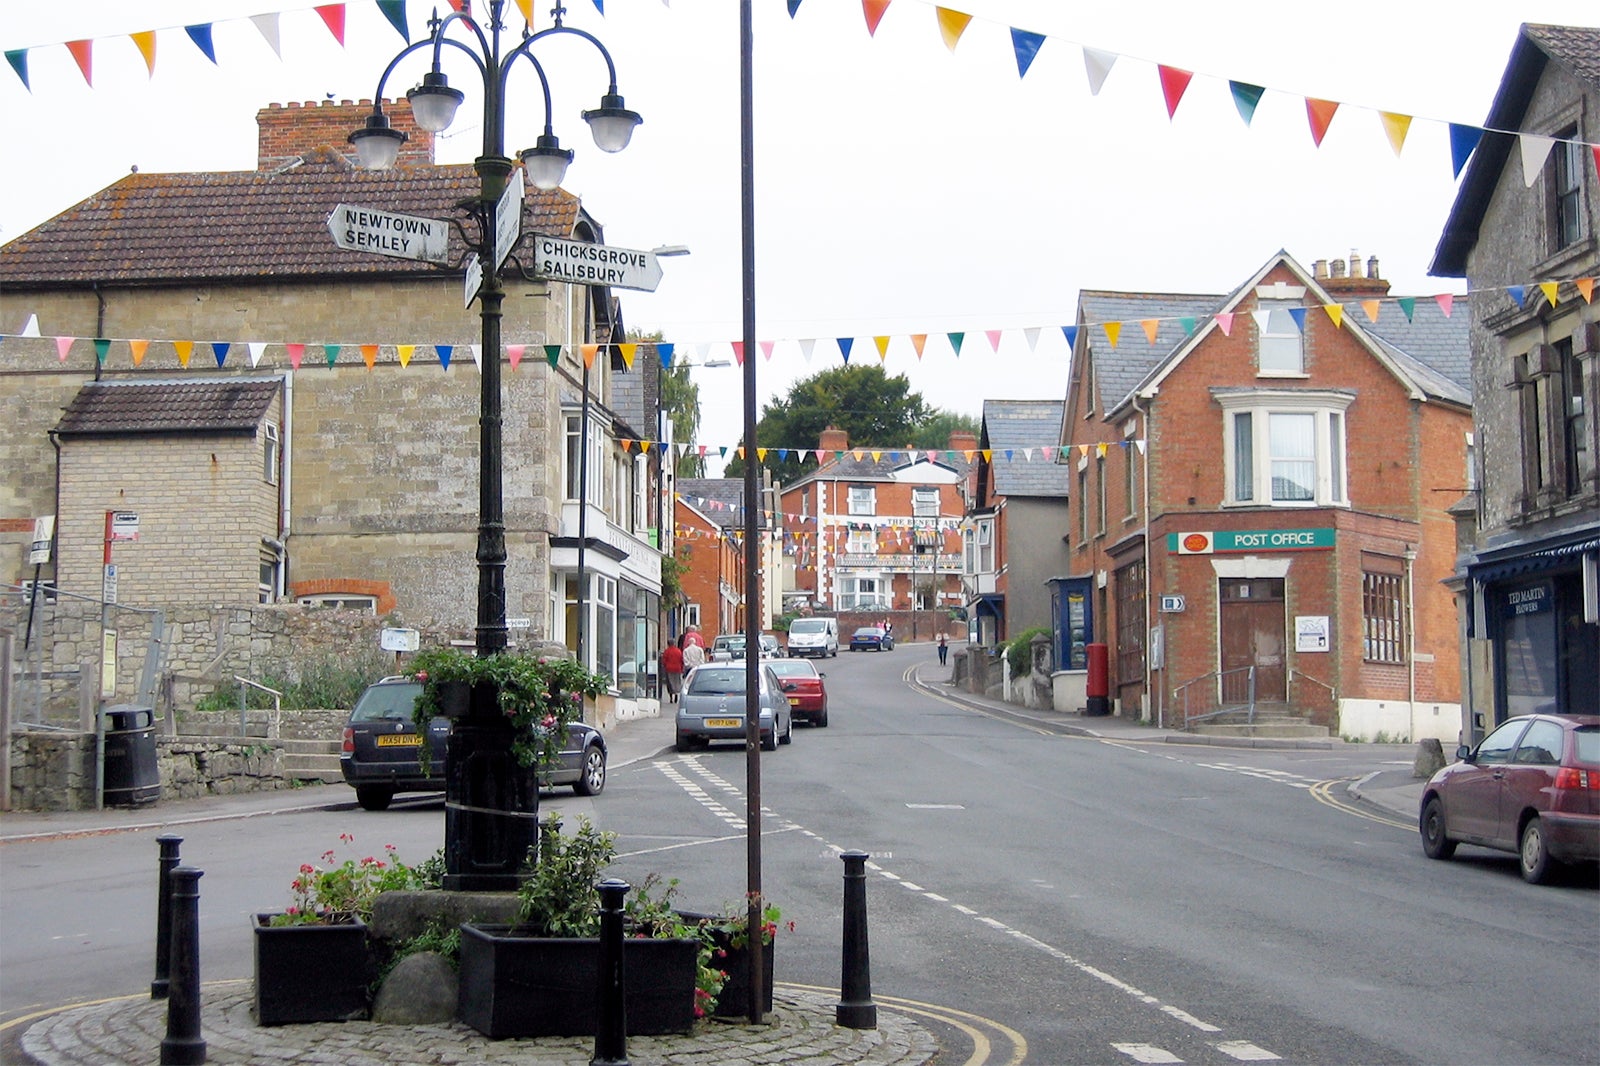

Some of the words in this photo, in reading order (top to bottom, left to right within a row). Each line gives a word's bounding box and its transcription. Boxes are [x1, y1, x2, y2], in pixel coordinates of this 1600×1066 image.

[345, 211, 431, 237] NEWTOWN
[345, 229, 411, 252] SEMLEY
[542, 242, 647, 268] CHICKSGROVE
[543, 260, 626, 283] SALISBURY
[1234, 533, 1269, 546] POST
[1271, 532, 1315, 545] OFFICE
[1508, 592, 1521, 604] TED
[1520, 587, 1545, 602] MARTIN
[1515, 602, 1538, 614] FLOWERS
